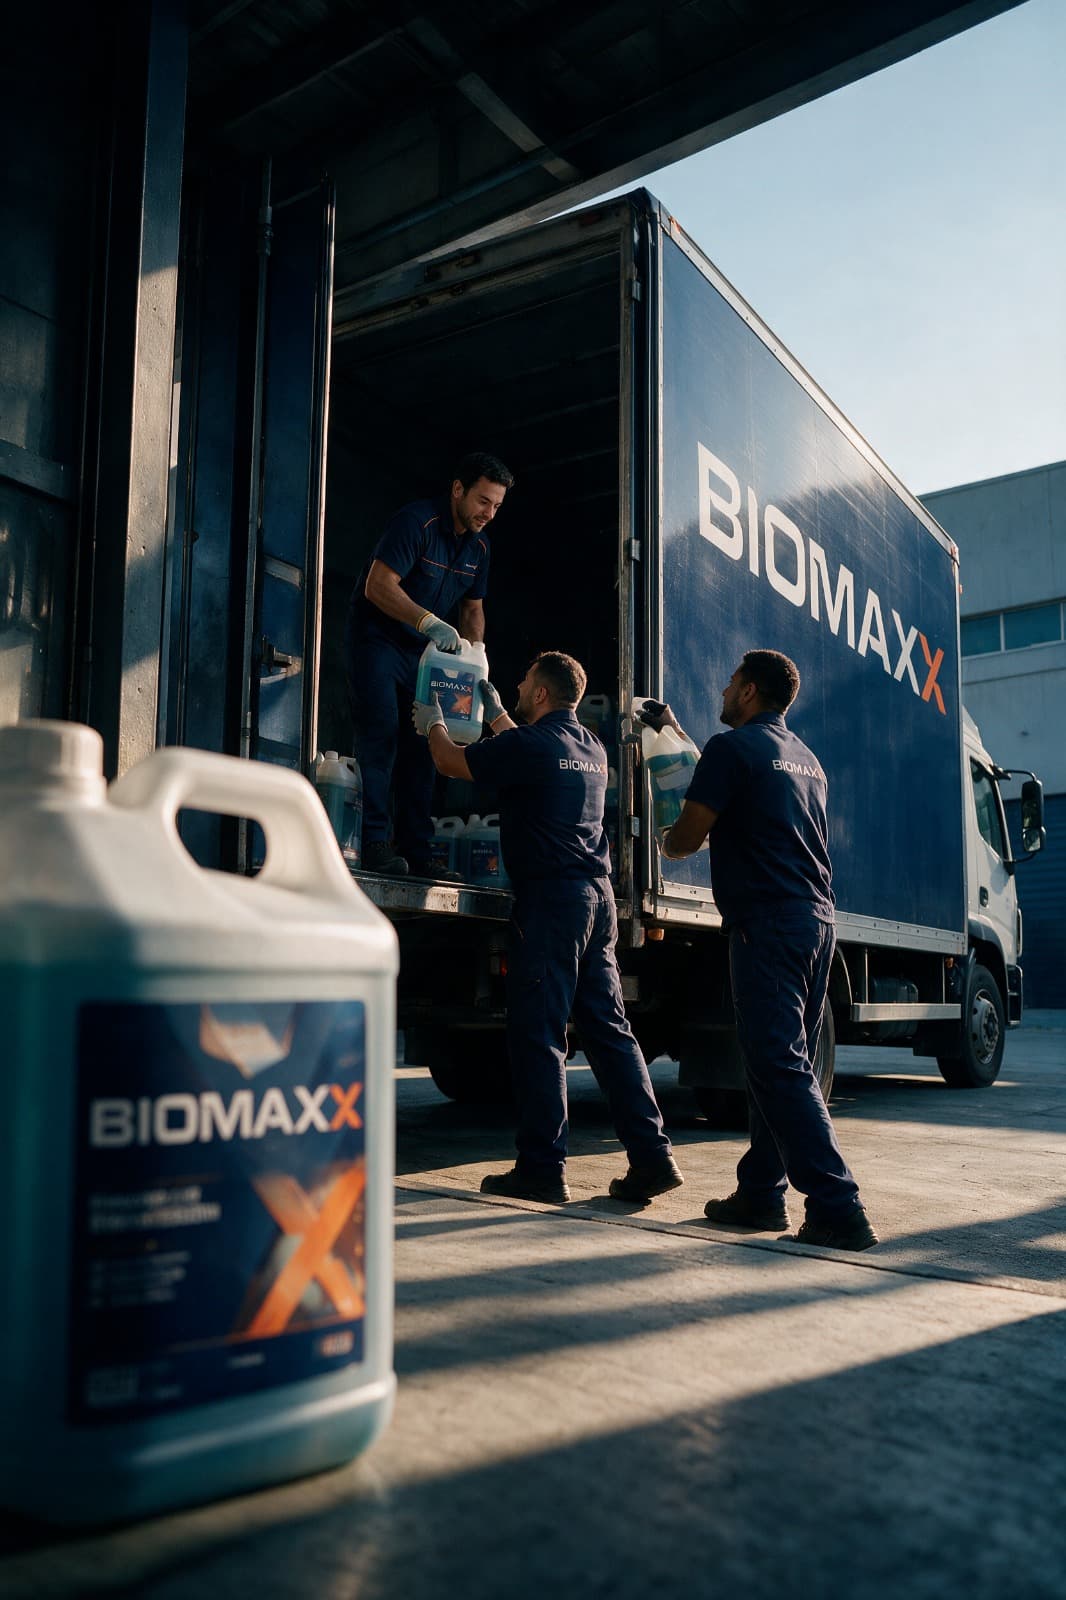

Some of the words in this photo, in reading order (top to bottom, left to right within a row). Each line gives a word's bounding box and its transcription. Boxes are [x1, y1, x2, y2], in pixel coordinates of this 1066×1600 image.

[698, 441, 946, 716] BIOMAXX
[430, 680, 473, 693] BIOMAXX
[91, 1081, 364, 1147] BIOMAXX
